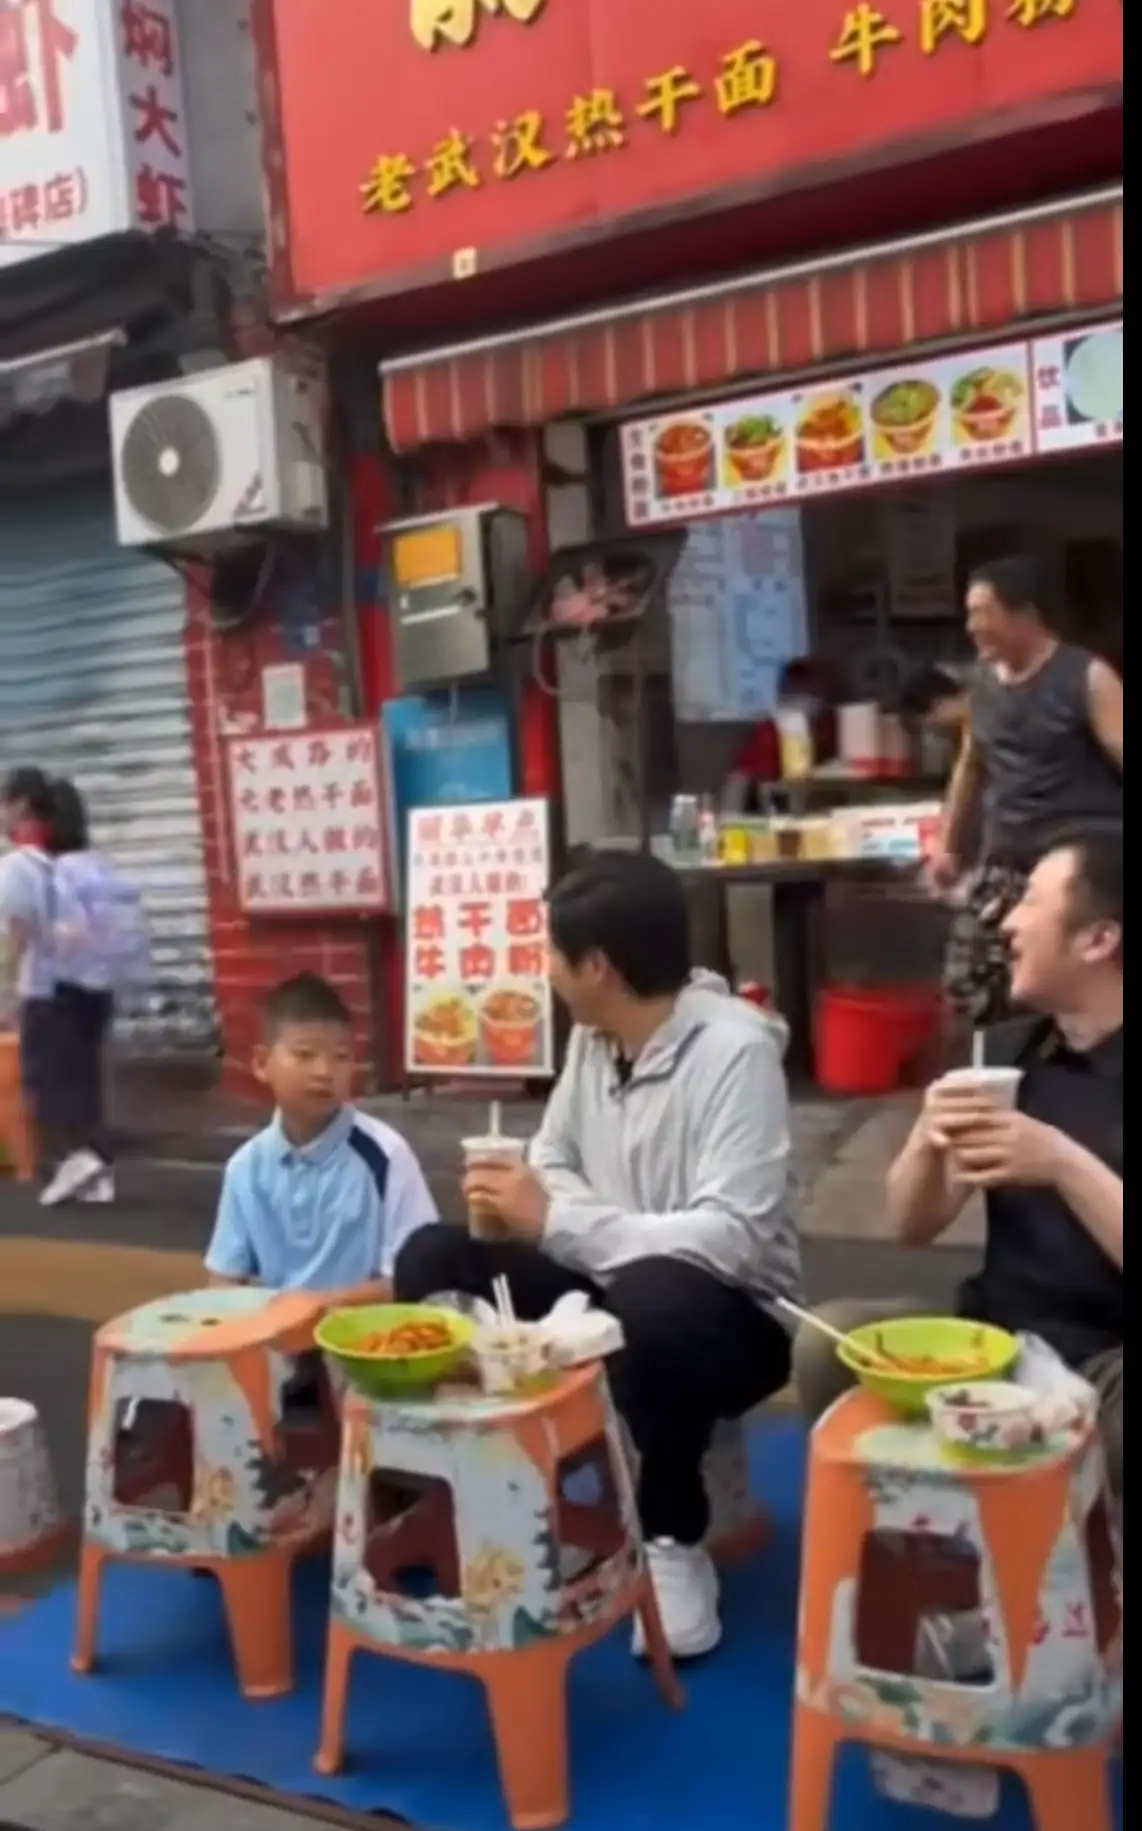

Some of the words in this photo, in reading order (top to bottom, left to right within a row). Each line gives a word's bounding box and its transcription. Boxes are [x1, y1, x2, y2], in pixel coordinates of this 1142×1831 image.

[359, 39, 777, 213] 老武汉热干面
[411, 898, 547, 940] 热干面
[412, 943, 545, 980] 牛肉粉
